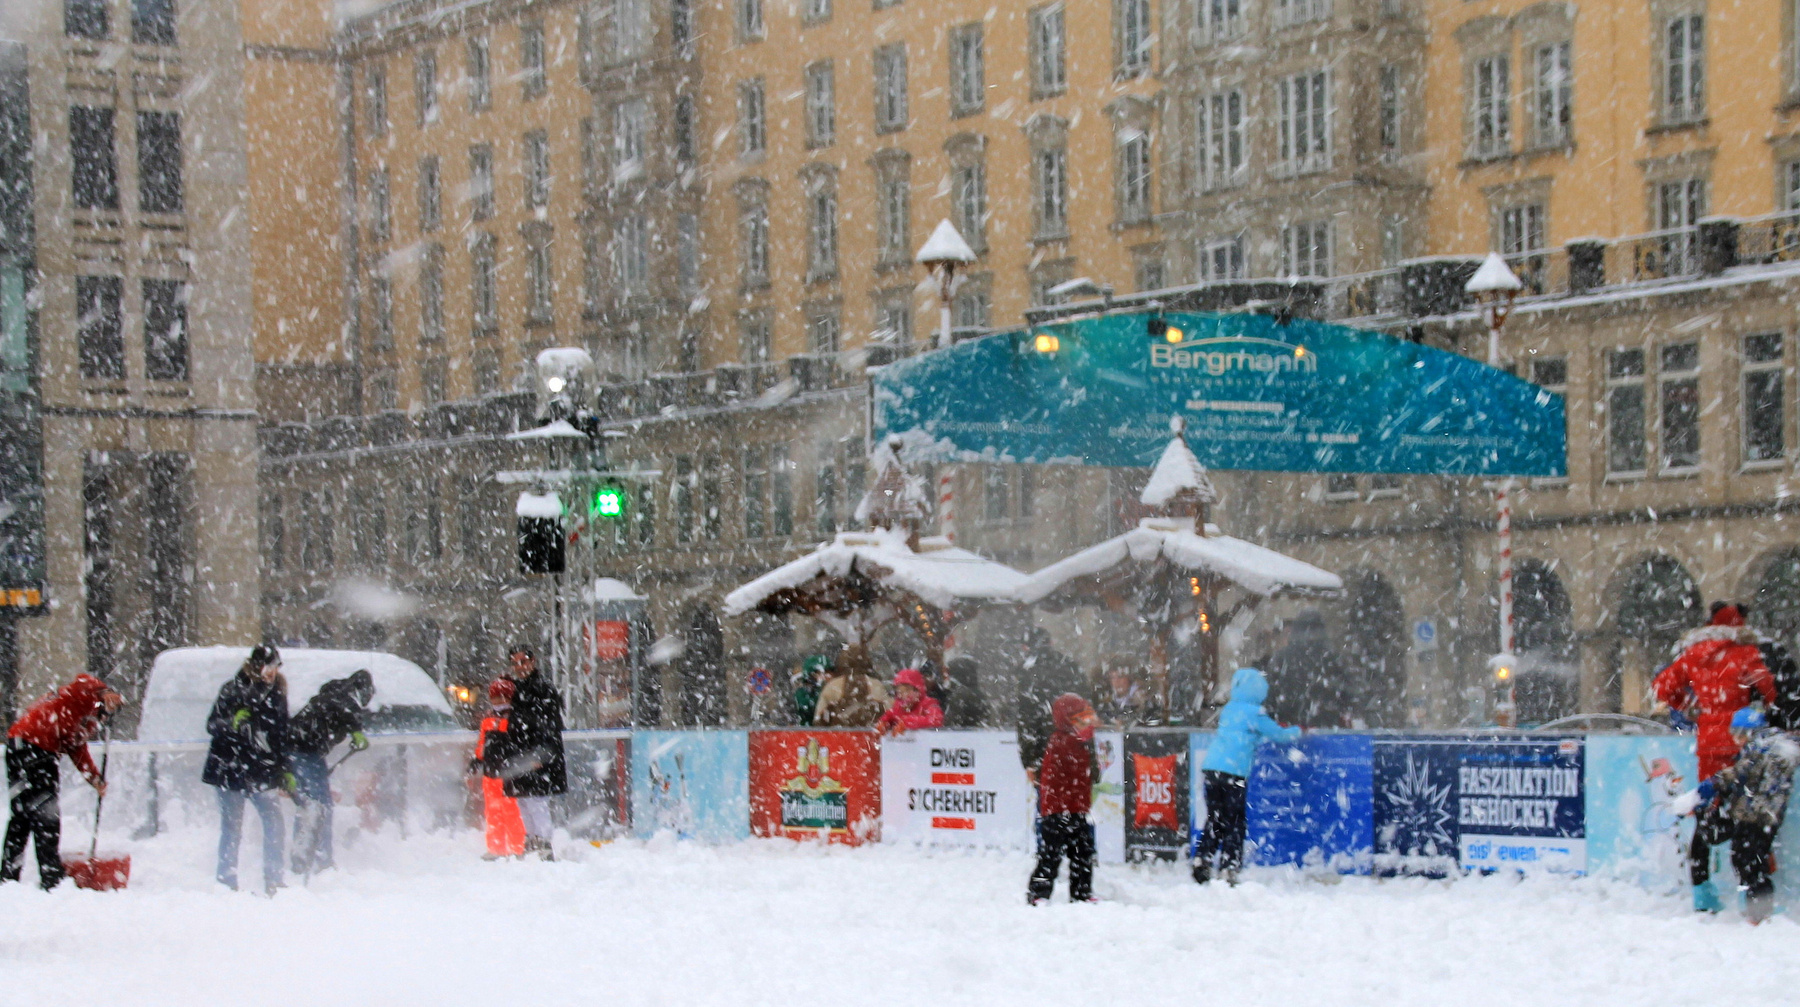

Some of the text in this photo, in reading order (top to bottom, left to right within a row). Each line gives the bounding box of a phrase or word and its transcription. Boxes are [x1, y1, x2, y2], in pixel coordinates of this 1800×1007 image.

[1151, 344, 1317, 376] Bergmann
[931, 748, 975, 768] DWSI
[1139, 773, 1172, 804] ibis
[1459, 766, 1579, 797] FASZINATION
[908, 788, 997, 813] SCHERHEIT
[1459, 796, 1559, 828] EISHOCKEY
